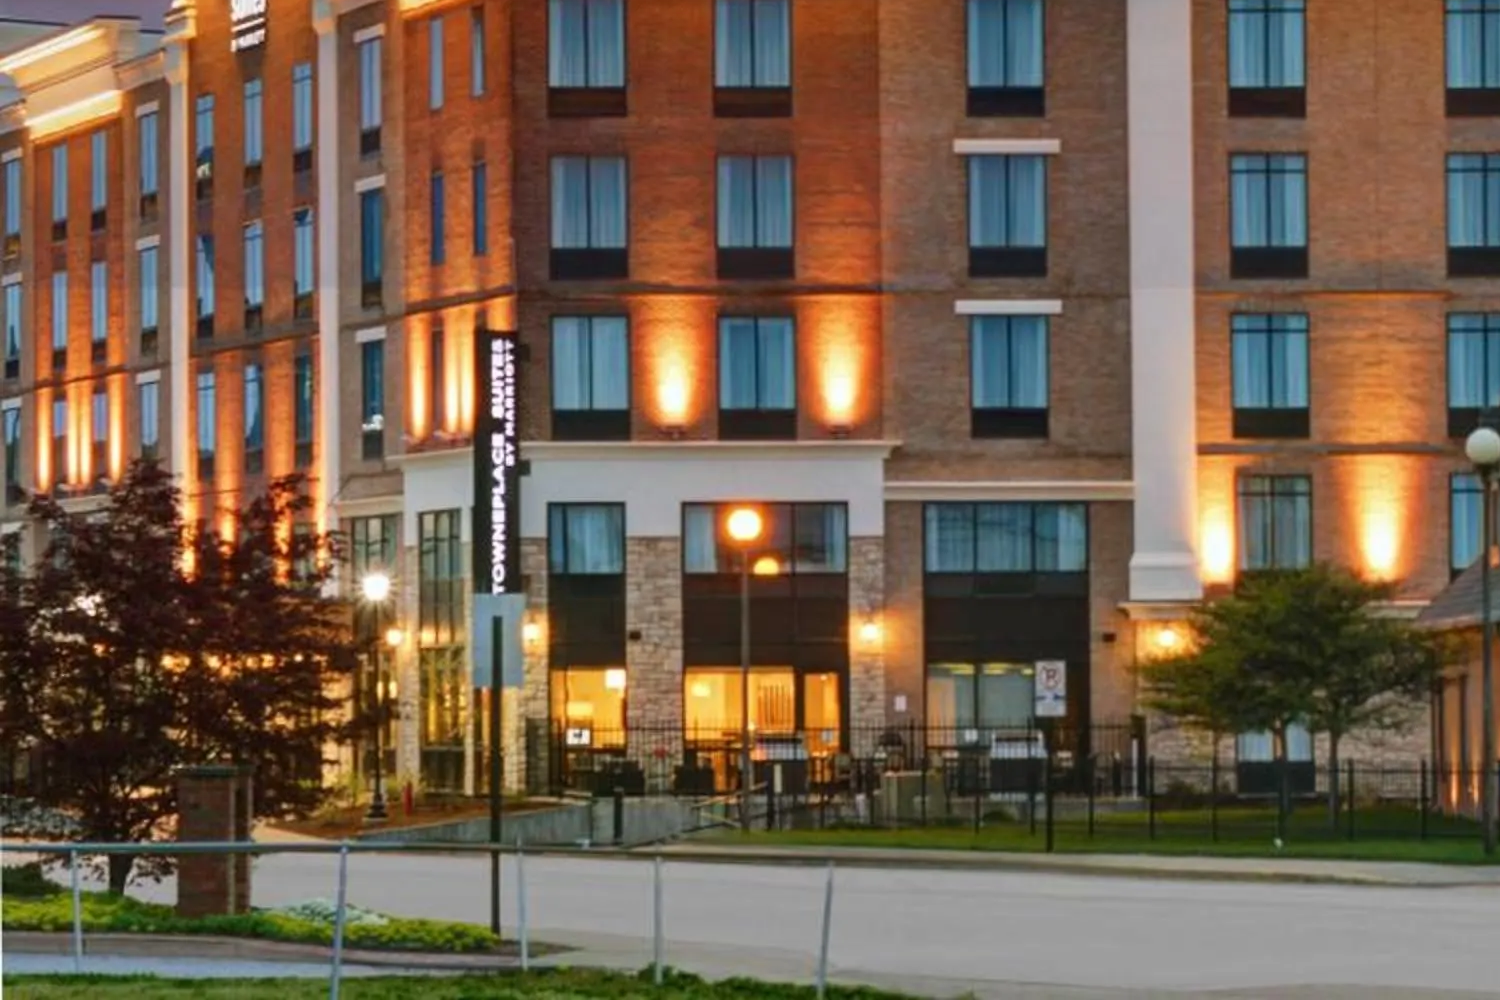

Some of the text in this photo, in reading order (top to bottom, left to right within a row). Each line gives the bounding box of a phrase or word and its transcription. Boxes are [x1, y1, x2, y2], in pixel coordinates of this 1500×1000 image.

[491, 338, 505, 596] TOWNEPLACE SUITES
[504, 338, 515, 467] BY MARRIOTT
